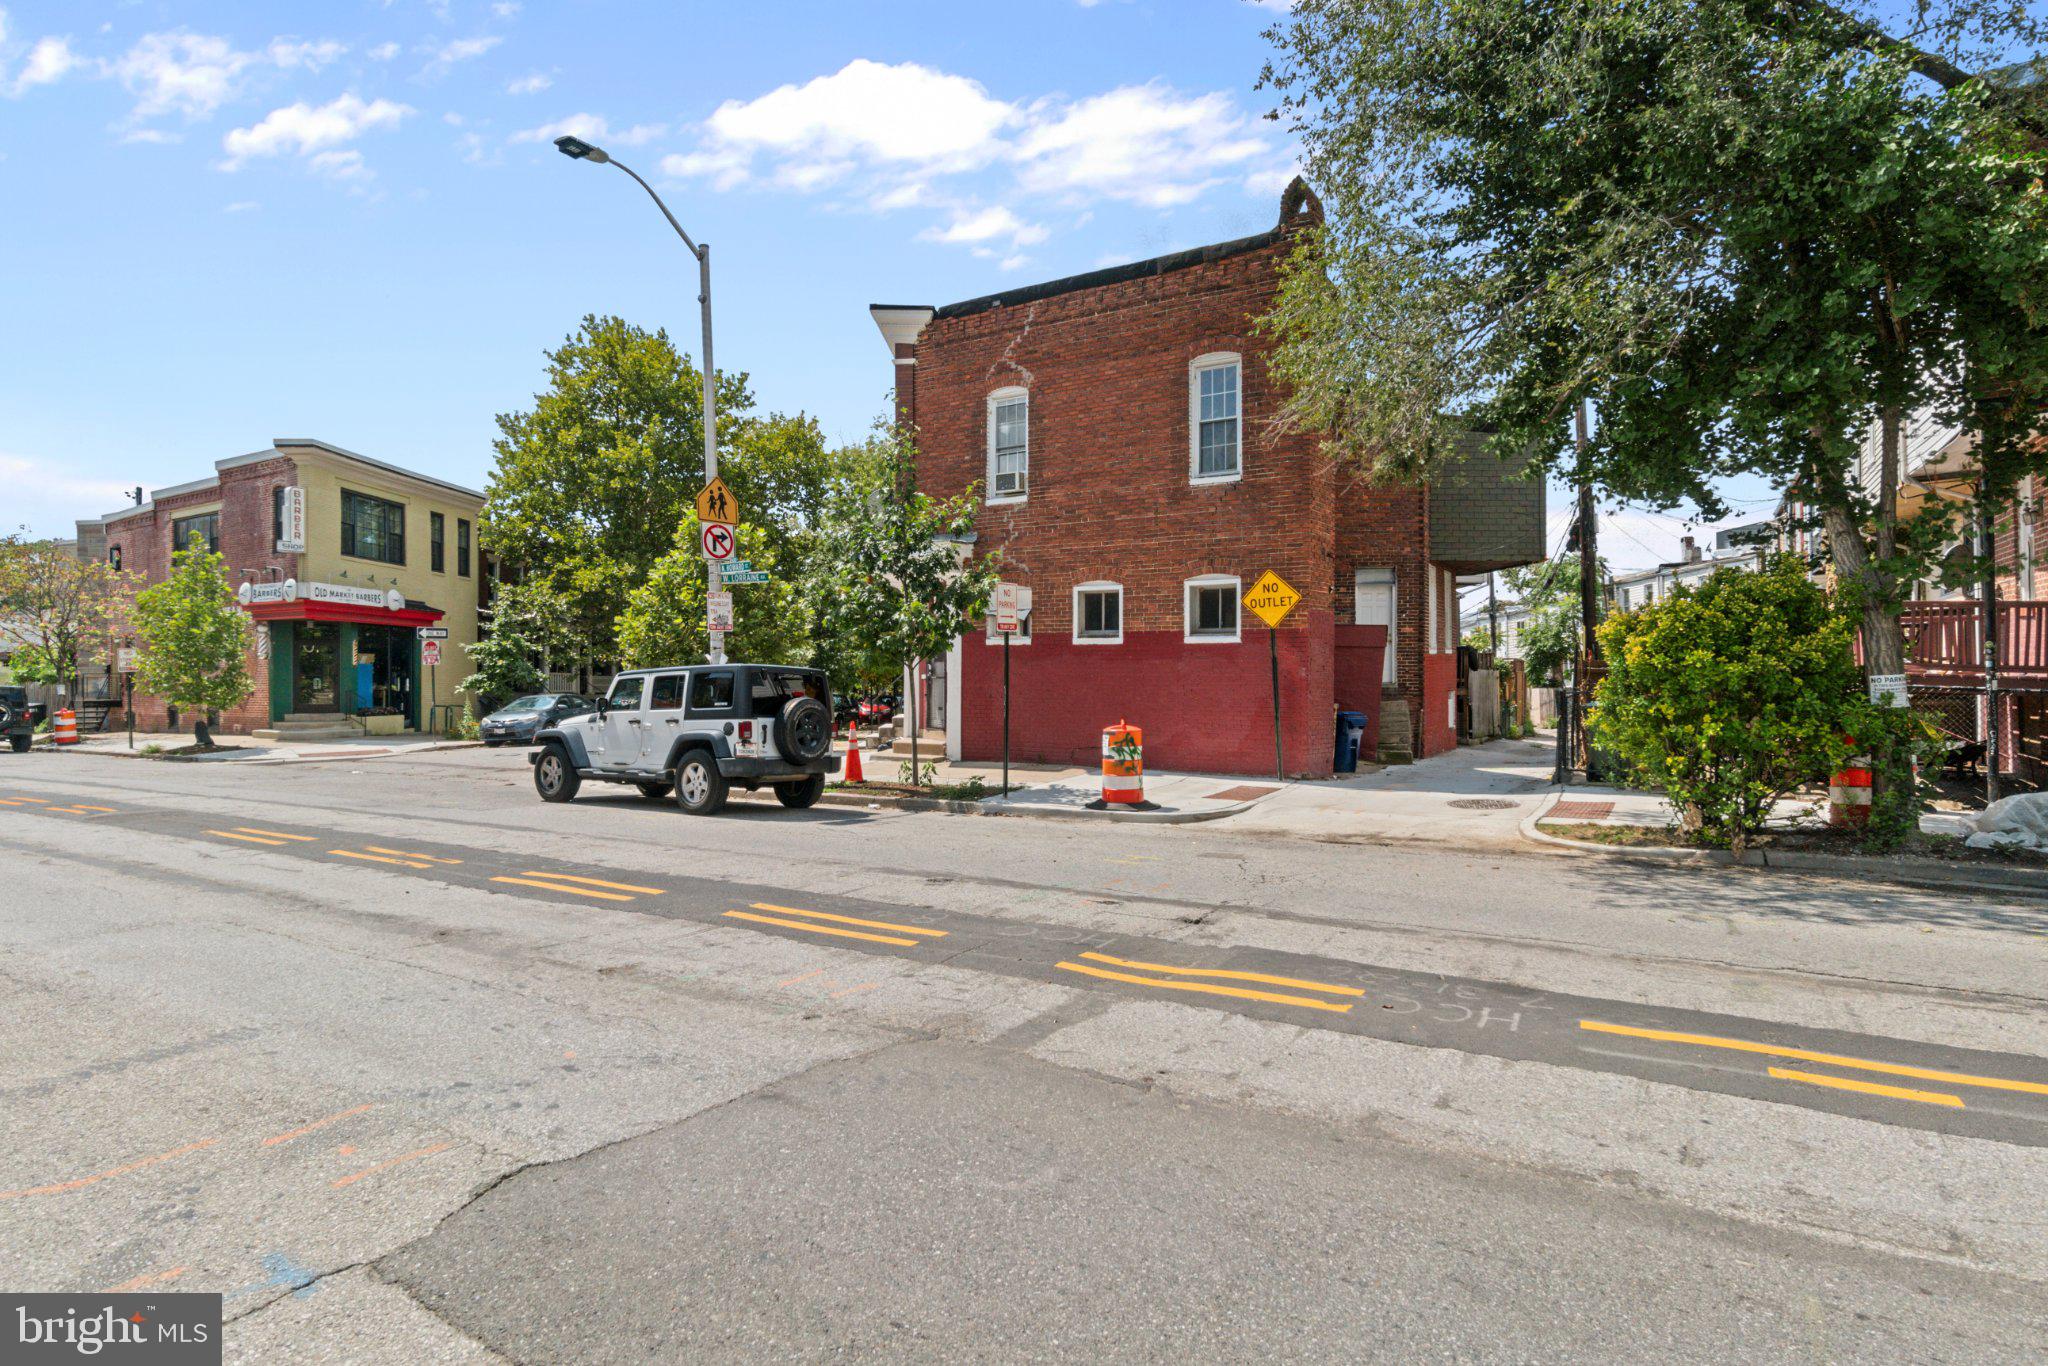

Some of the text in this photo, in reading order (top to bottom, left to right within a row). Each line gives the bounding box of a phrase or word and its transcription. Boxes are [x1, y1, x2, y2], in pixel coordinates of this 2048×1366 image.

[293, 490, 302, 540] BARBER
[731, 573, 759, 582] LORRAINE
[253, 587, 282, 598] BARBERS
[1003, 589, 1011, 597] NO
[1262, 583, 1278, 593] NO
[315, 586, 382, 604] OLD MARKET BARBERS
[999, 600, 1016, 609] PARKING
[1250, 595, 1293, 609] OUTLET
